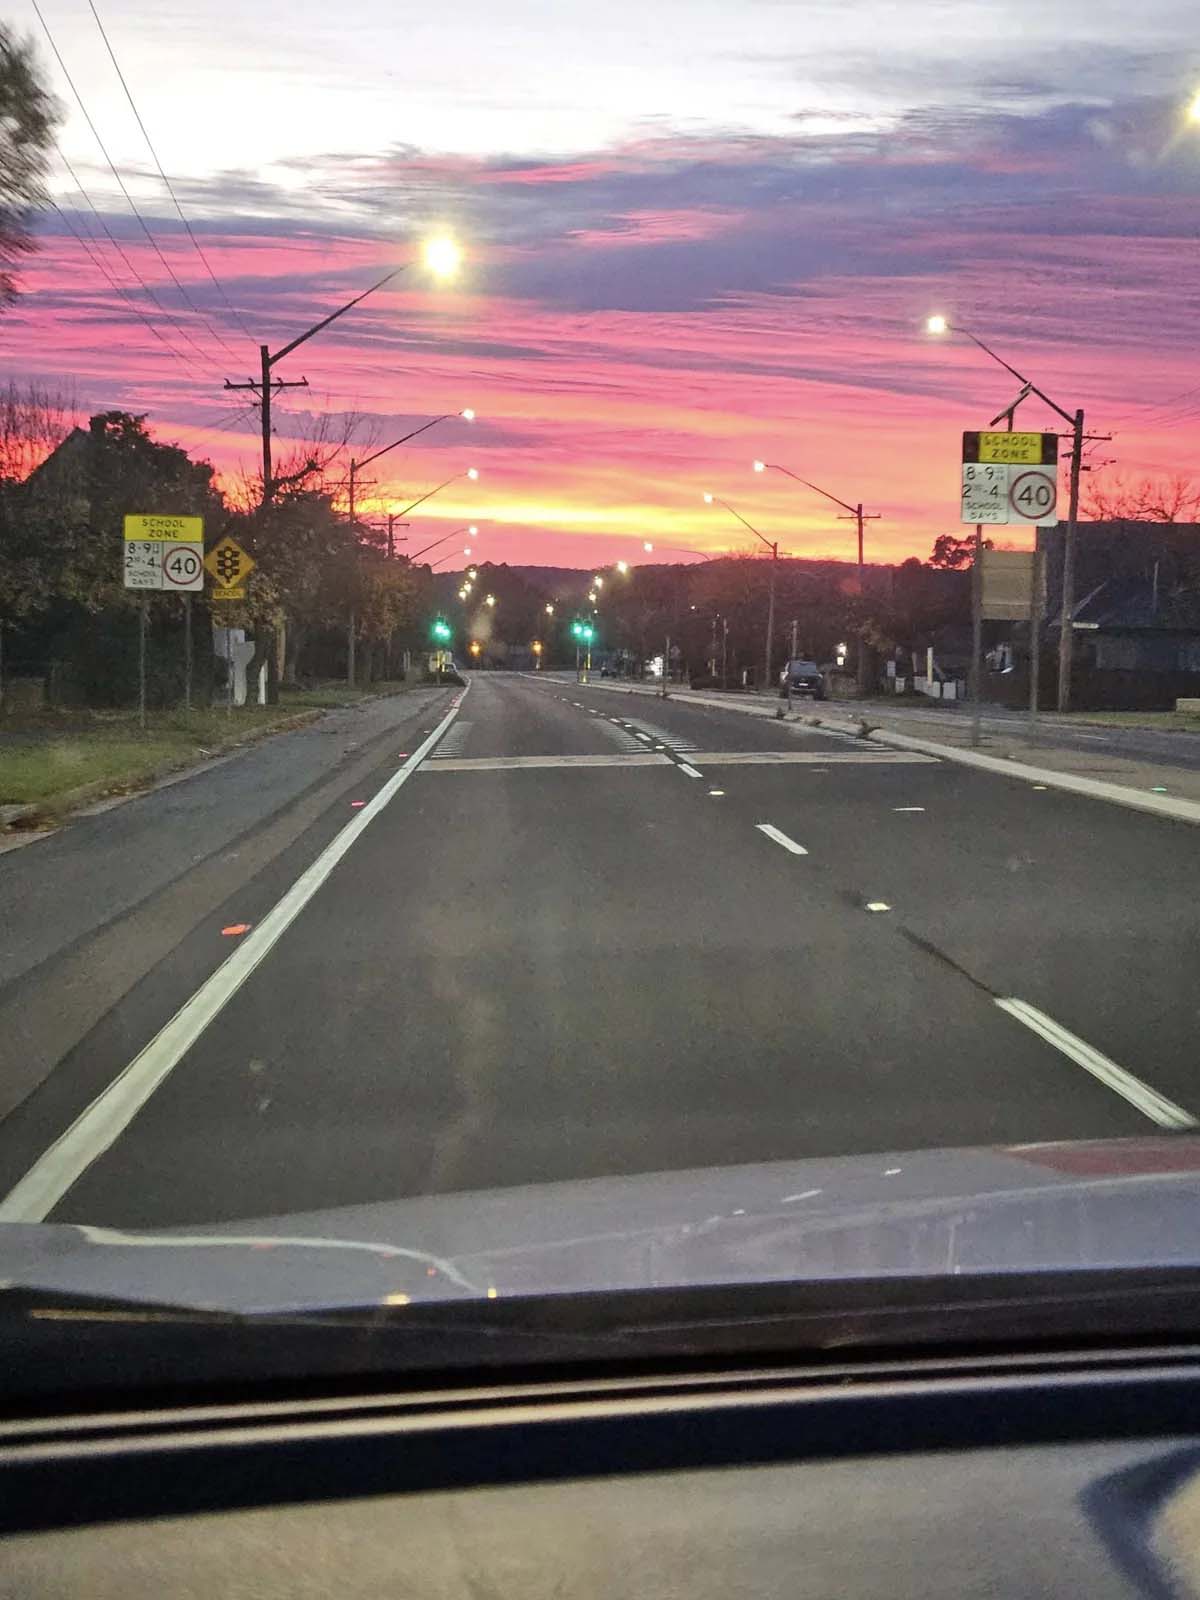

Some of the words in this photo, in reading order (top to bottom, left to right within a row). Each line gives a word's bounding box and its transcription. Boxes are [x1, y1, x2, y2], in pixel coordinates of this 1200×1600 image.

[985, 435, 1037, 447] SCHOOL
[991, 449, 1029, 459] ZONE
[1018, 485, 1050, 506] 40
[142, 518, 185, 528] SCHOOL
[148, 529, 179, 538] ZONE
[170, 557, 196, 575] 40
